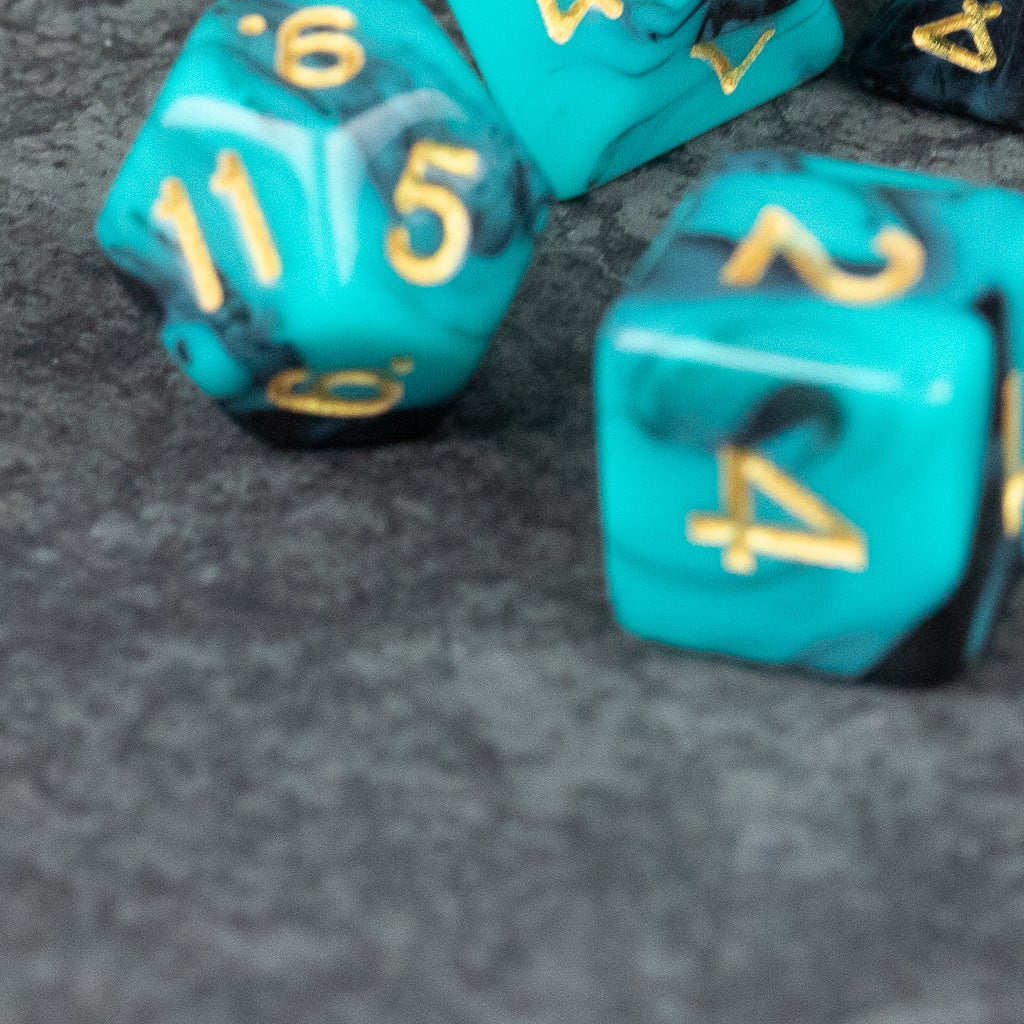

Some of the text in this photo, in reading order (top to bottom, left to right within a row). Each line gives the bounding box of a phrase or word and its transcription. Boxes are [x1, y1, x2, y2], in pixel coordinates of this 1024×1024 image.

[152, 149, 282, 313] 11
[385, 139, 480, 287] 5
[720, 204, 926, 304] 2
[686, 442, 868, 576] 4
